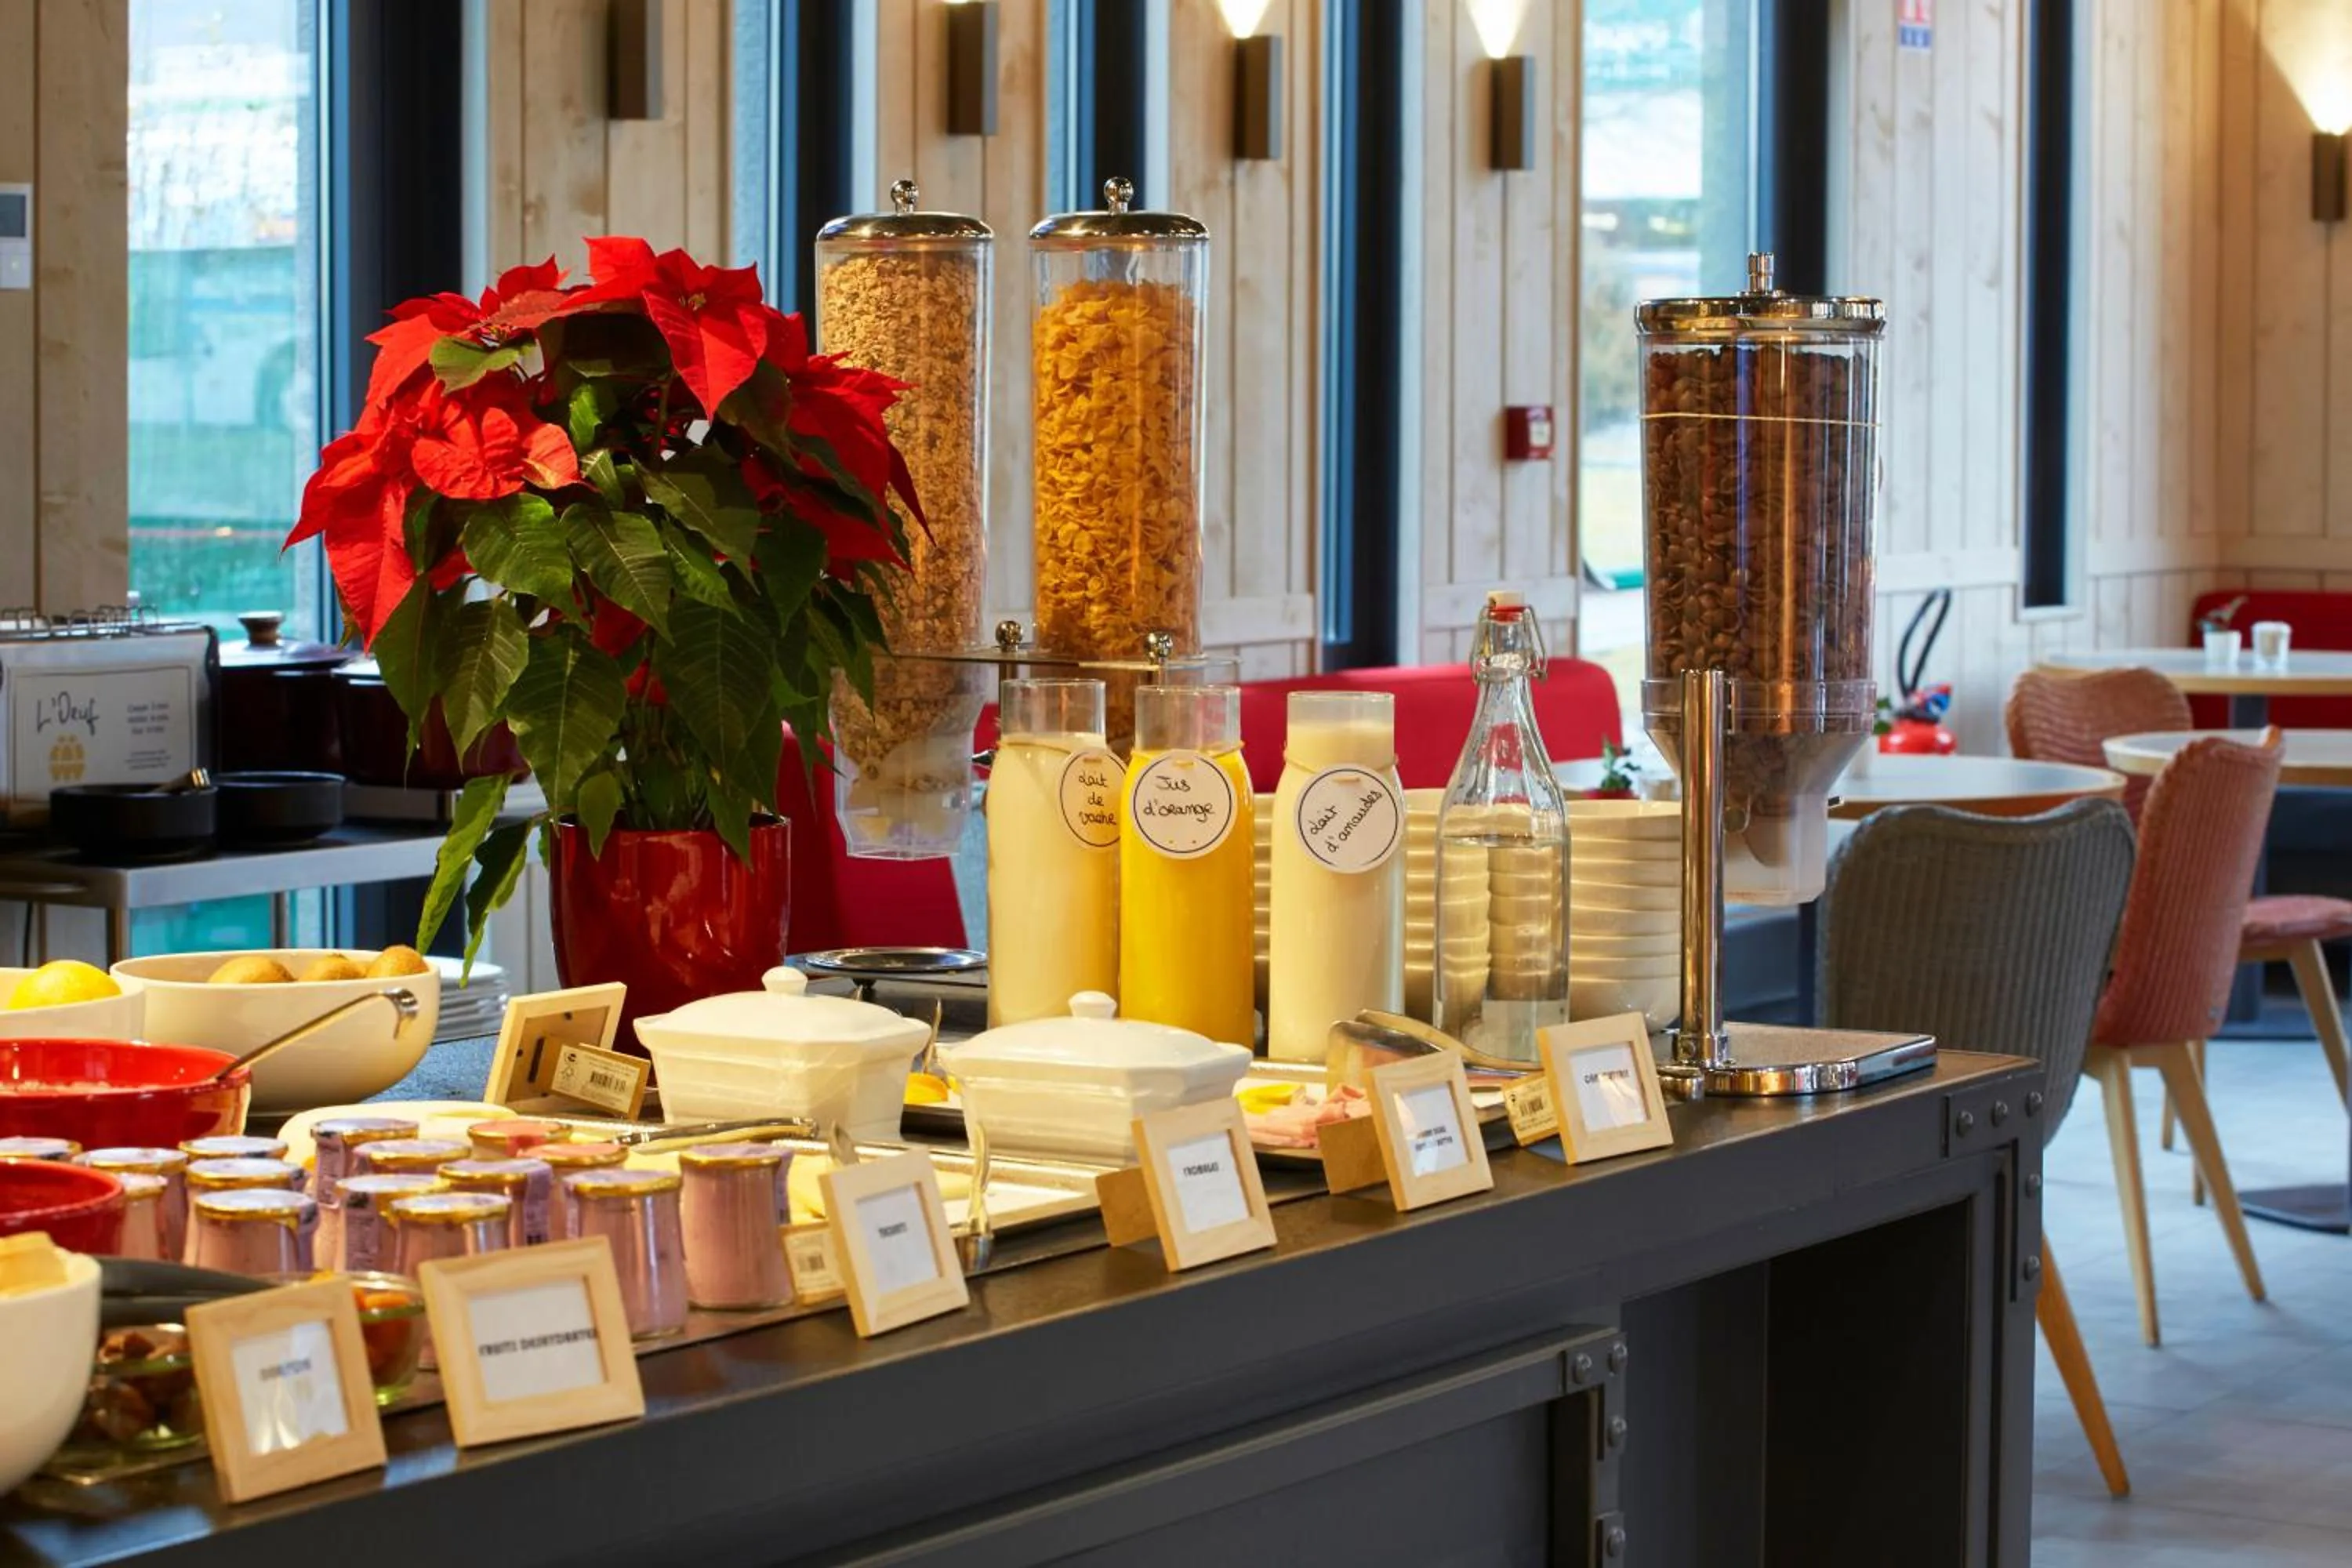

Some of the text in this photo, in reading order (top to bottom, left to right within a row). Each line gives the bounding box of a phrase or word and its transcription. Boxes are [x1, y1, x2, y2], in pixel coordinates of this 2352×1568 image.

[1156, 775, 1191, 793] Jus
[1087, 791, 1105, 807] de
[1143, 798, 1216, 823] d'orange
